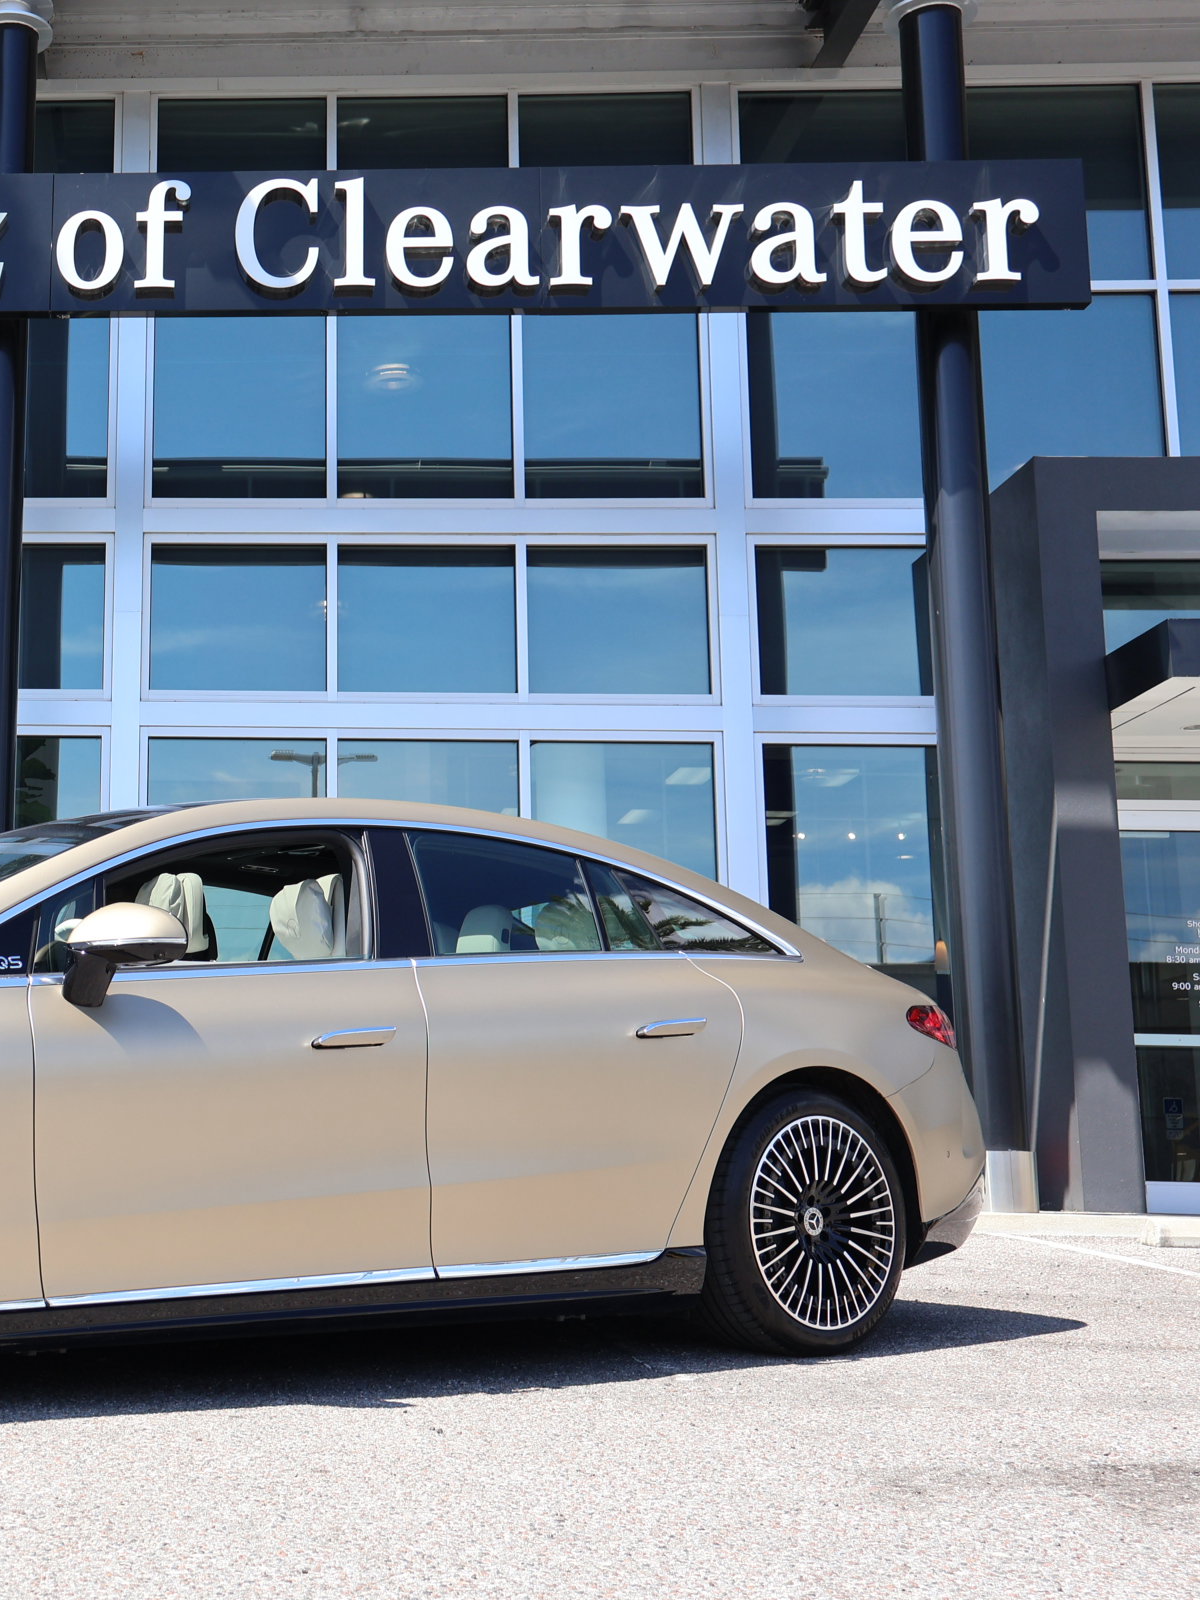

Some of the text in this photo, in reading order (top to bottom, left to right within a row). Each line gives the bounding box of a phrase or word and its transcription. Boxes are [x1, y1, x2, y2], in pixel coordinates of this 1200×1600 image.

[55, 179, 191, 291] of
[234, 175, 1040, 290] Clearwater
[1175, 946, 1200, 954] Mond
[1166, 955, 1186, 963] 8:30
[1172, 982, 1191, 990] 9:00
